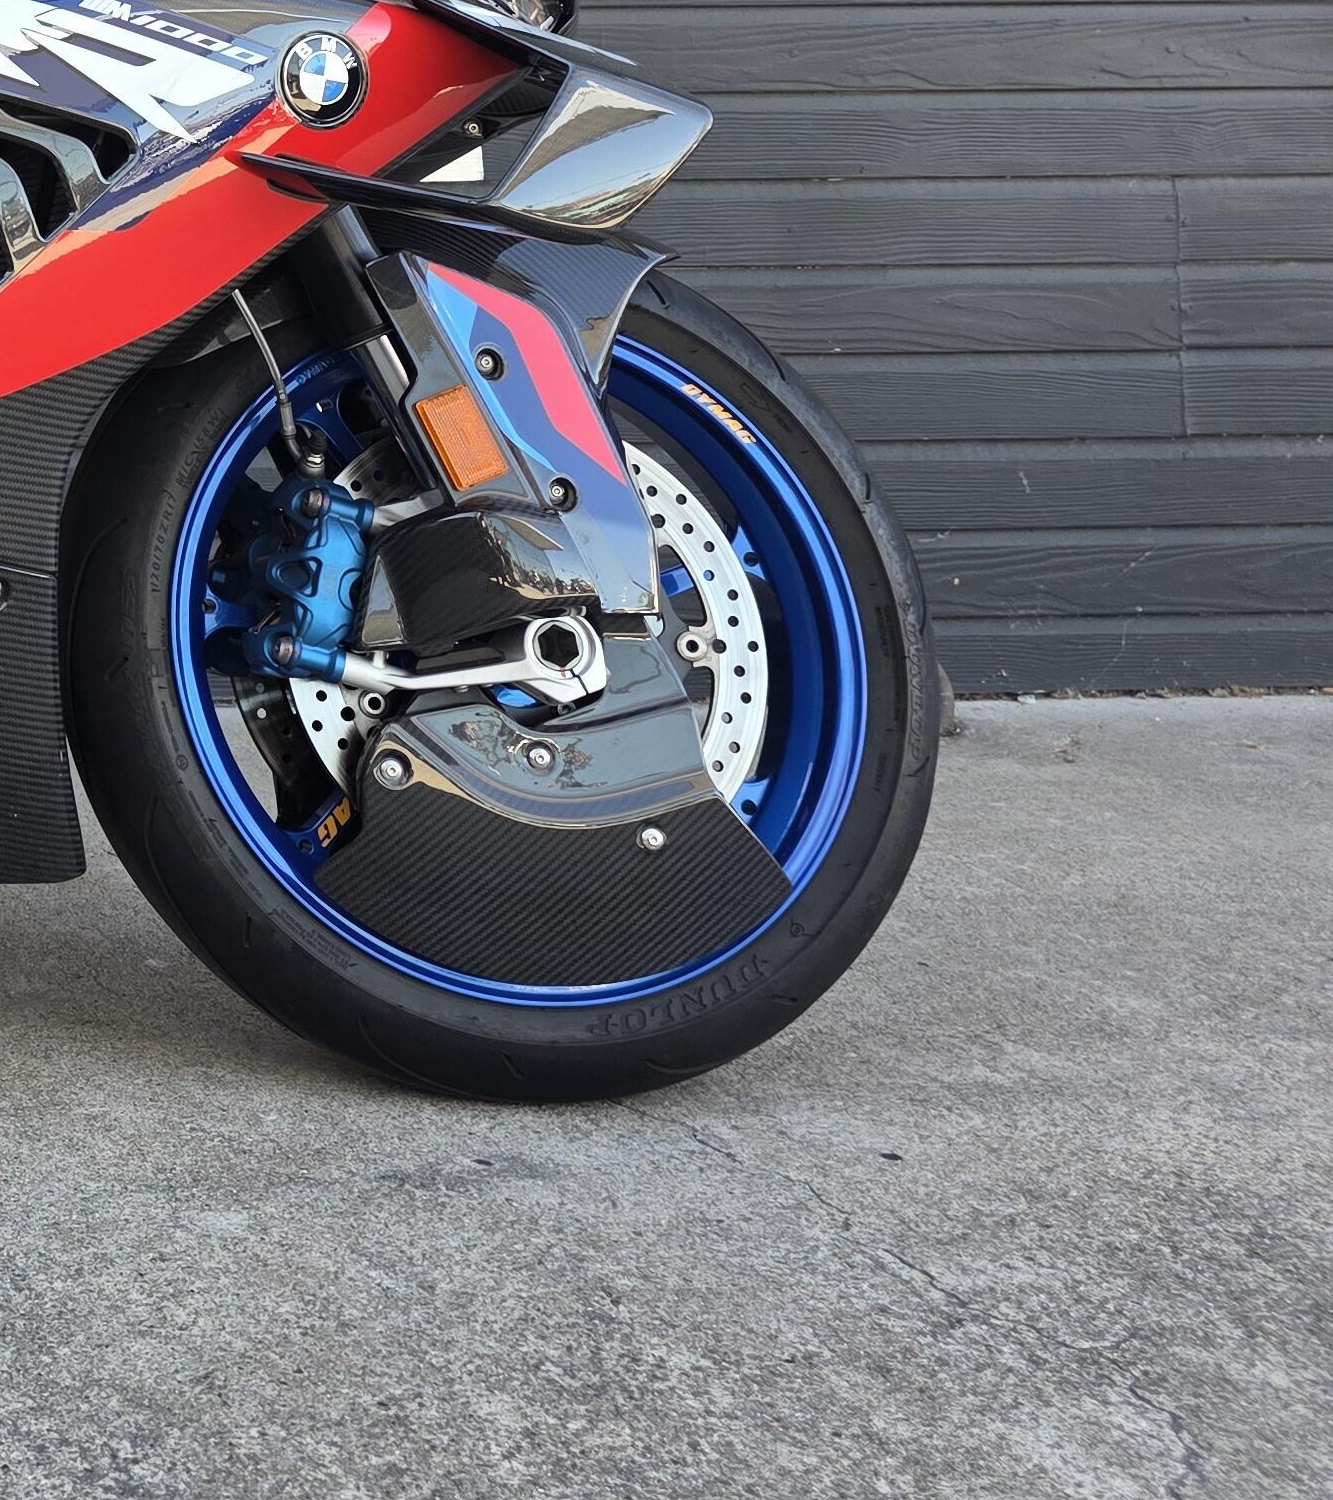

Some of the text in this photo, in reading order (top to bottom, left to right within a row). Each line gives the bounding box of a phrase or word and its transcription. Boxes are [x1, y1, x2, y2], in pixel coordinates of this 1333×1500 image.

[294, 35, 358, 70] BMW
[680, 383, 757, 444] DYMAG
[588, 954, 766, 1036] DUNLOP
